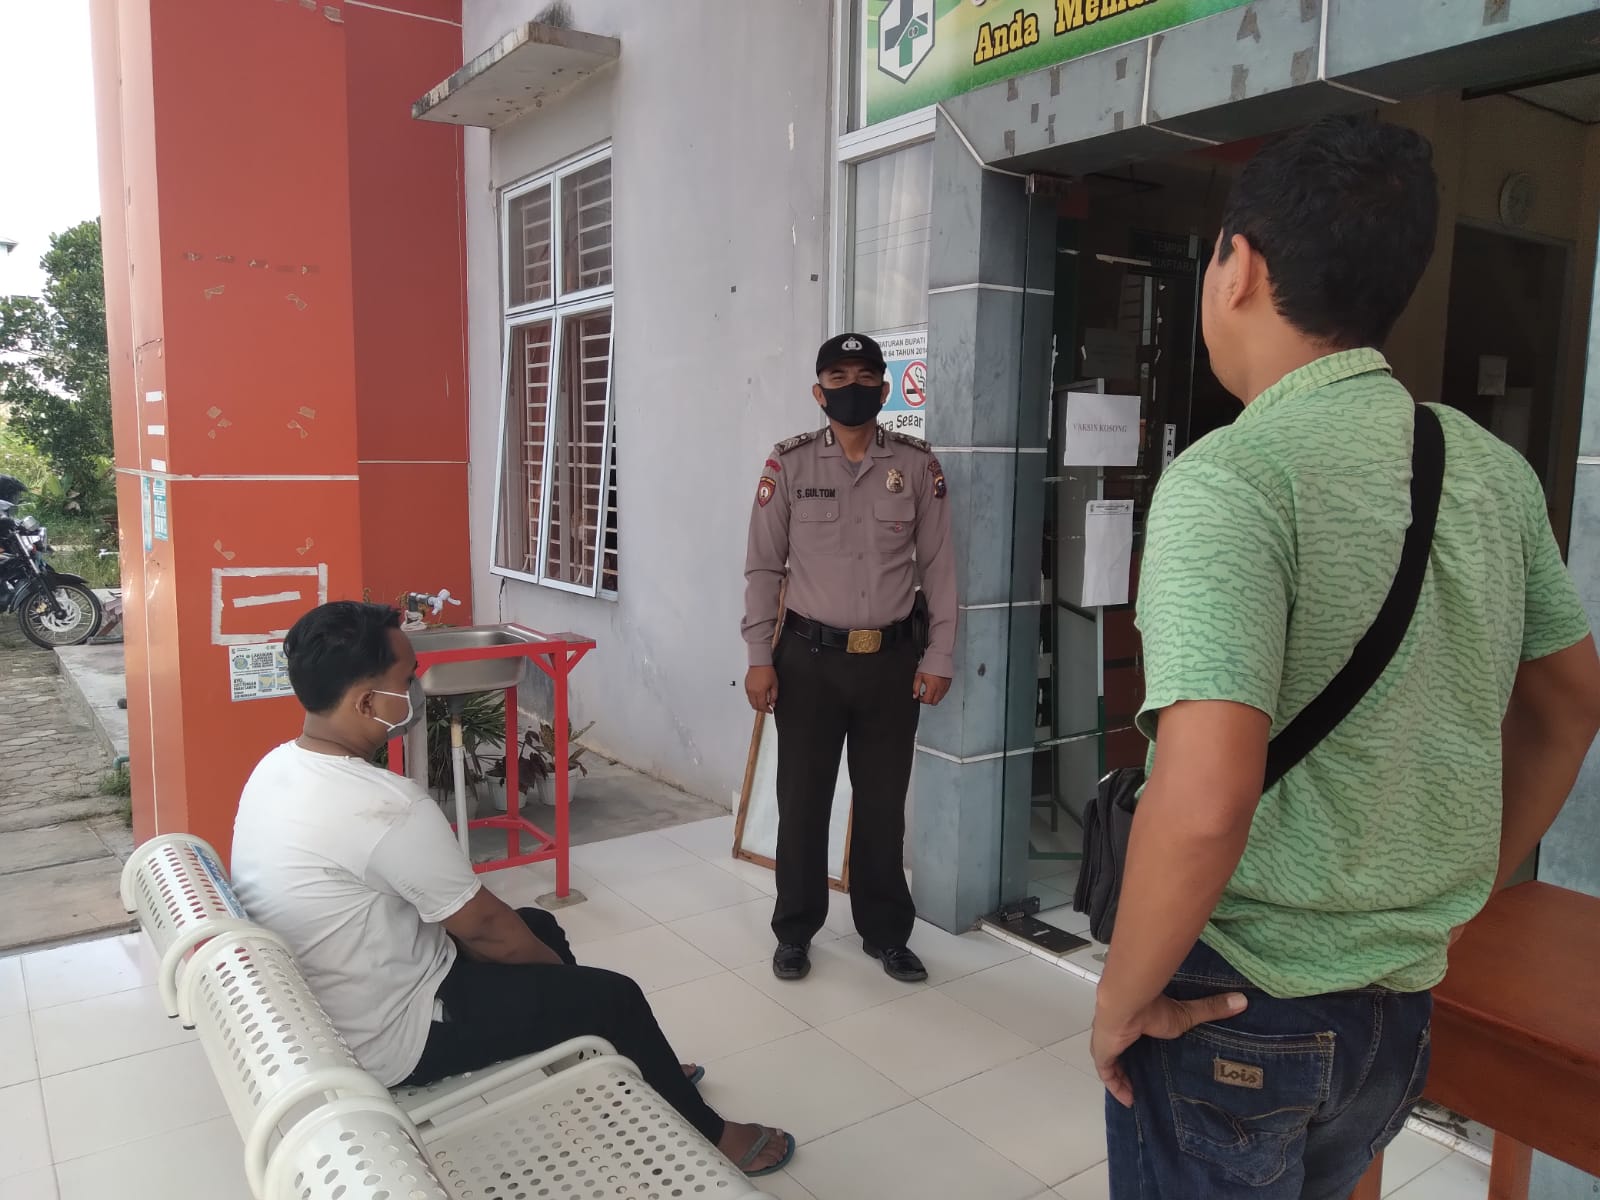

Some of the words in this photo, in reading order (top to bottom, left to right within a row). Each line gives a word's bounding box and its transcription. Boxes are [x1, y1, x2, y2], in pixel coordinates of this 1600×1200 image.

[974, 9, 1039, 65] Anda
[905, 336, 926, 346] BUPATI
[895, 348, 915, 357] TAHUN
[896, 414, 924, 429] Segar
[1073, 423, 1099, 433] VAKSIN
[1099, 423, 1128, 433] KOSONG
[796, 487, 836, 499] S.GULTOM
[1219, 1064, 1258, 1084] Lois
